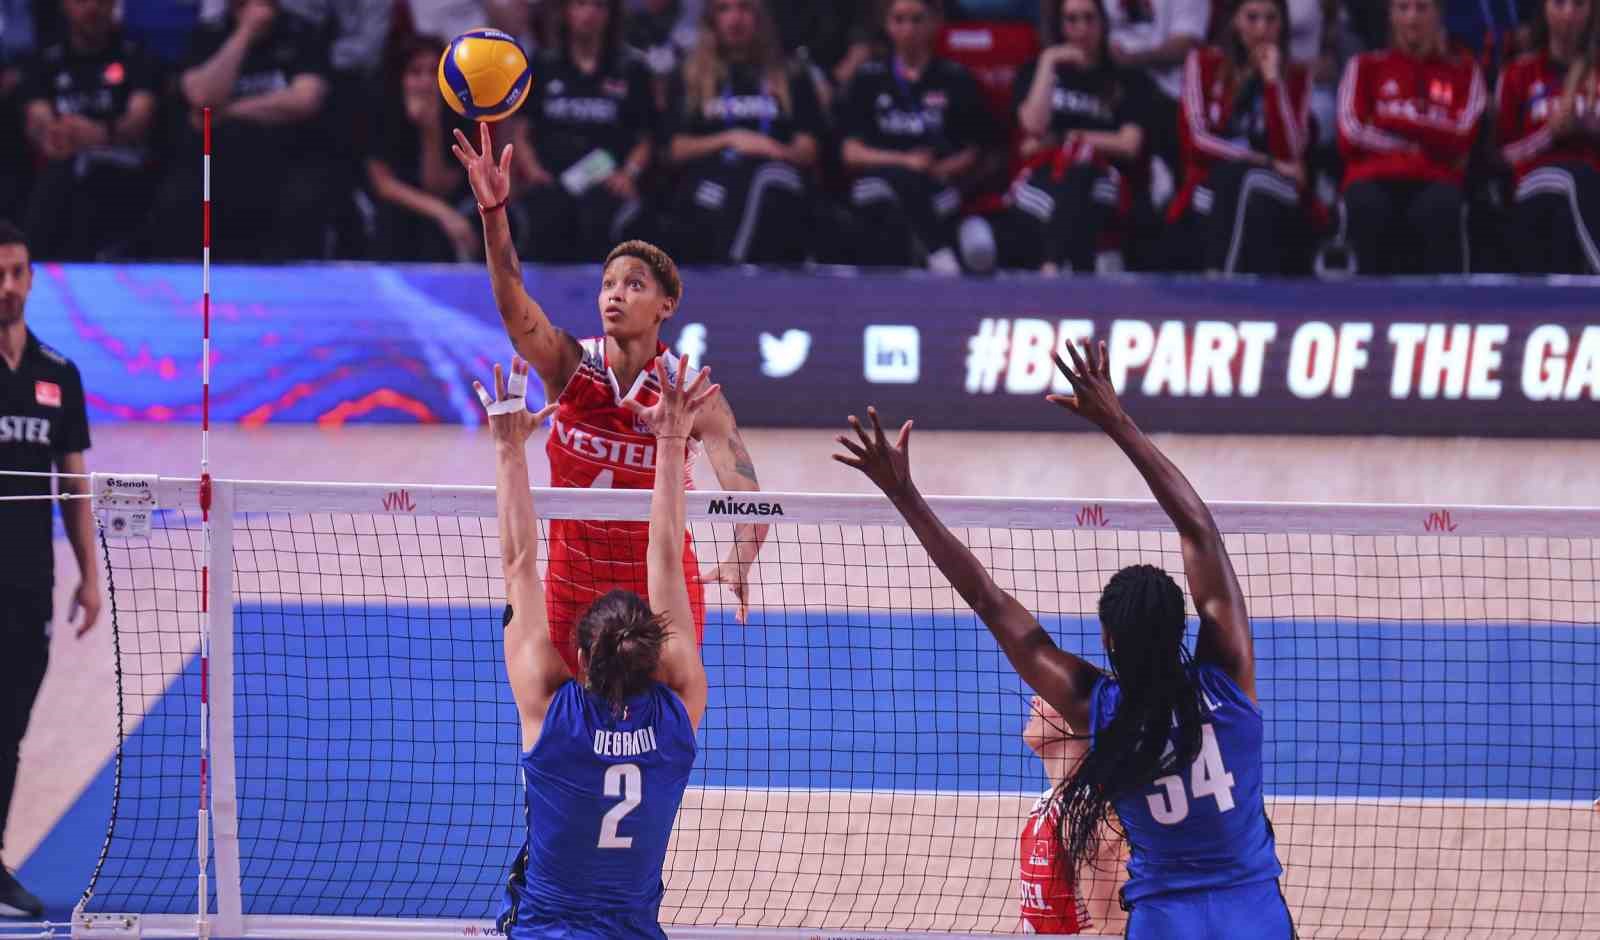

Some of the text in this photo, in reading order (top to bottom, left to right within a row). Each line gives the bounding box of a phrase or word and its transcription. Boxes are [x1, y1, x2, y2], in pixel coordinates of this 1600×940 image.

[966, 318, 1600, 401] #BE PART OF THE GA
[555, 420, 656, 470] VESTEL
[115, 479, 149, 489] Senoh
[382, 488, 417, 512] VNL
[1075, 503, 1111, 527] VNL
[1423, 508, 1458, 532] VNL
[593, 726, 657, 757] DEGRADI
[597, 763, 642, 849] 2
